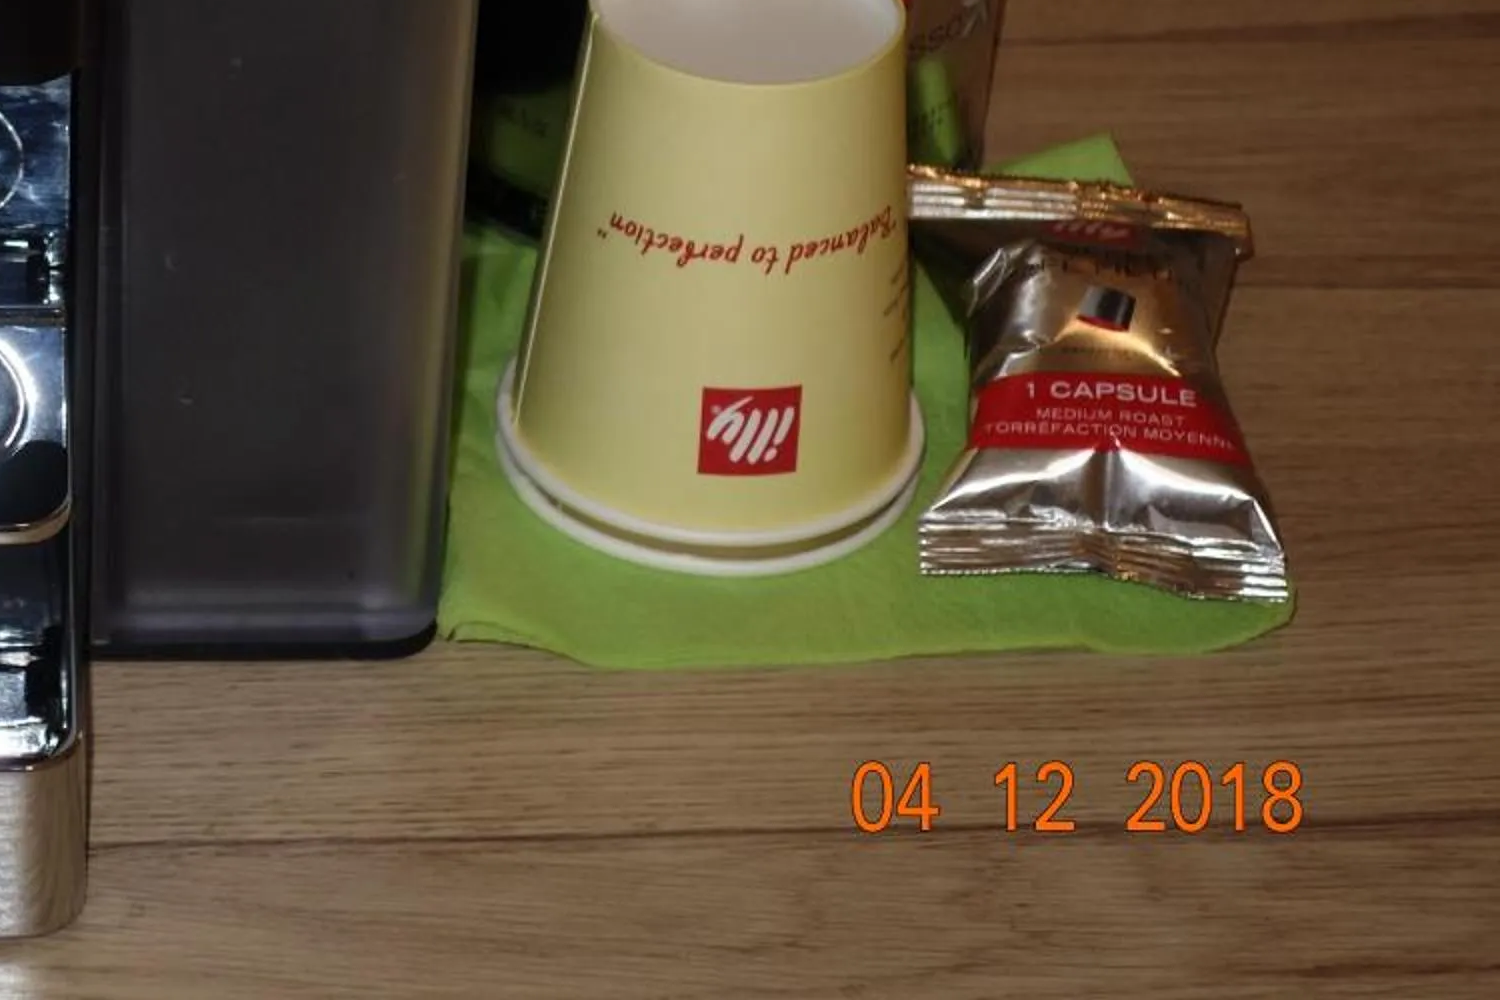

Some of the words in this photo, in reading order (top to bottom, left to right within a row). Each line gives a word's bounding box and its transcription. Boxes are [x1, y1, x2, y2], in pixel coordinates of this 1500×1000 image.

[750, 249, 780, 275] to
[1025, 382, 1035, 397] 1
[1050, 380, 1197, 407] CAPSULE
[1036, 407, 1113, 422] MEDIUM
[1119, 409, 1186, 428] ROAST
[706, 396, 796, 466] illy
